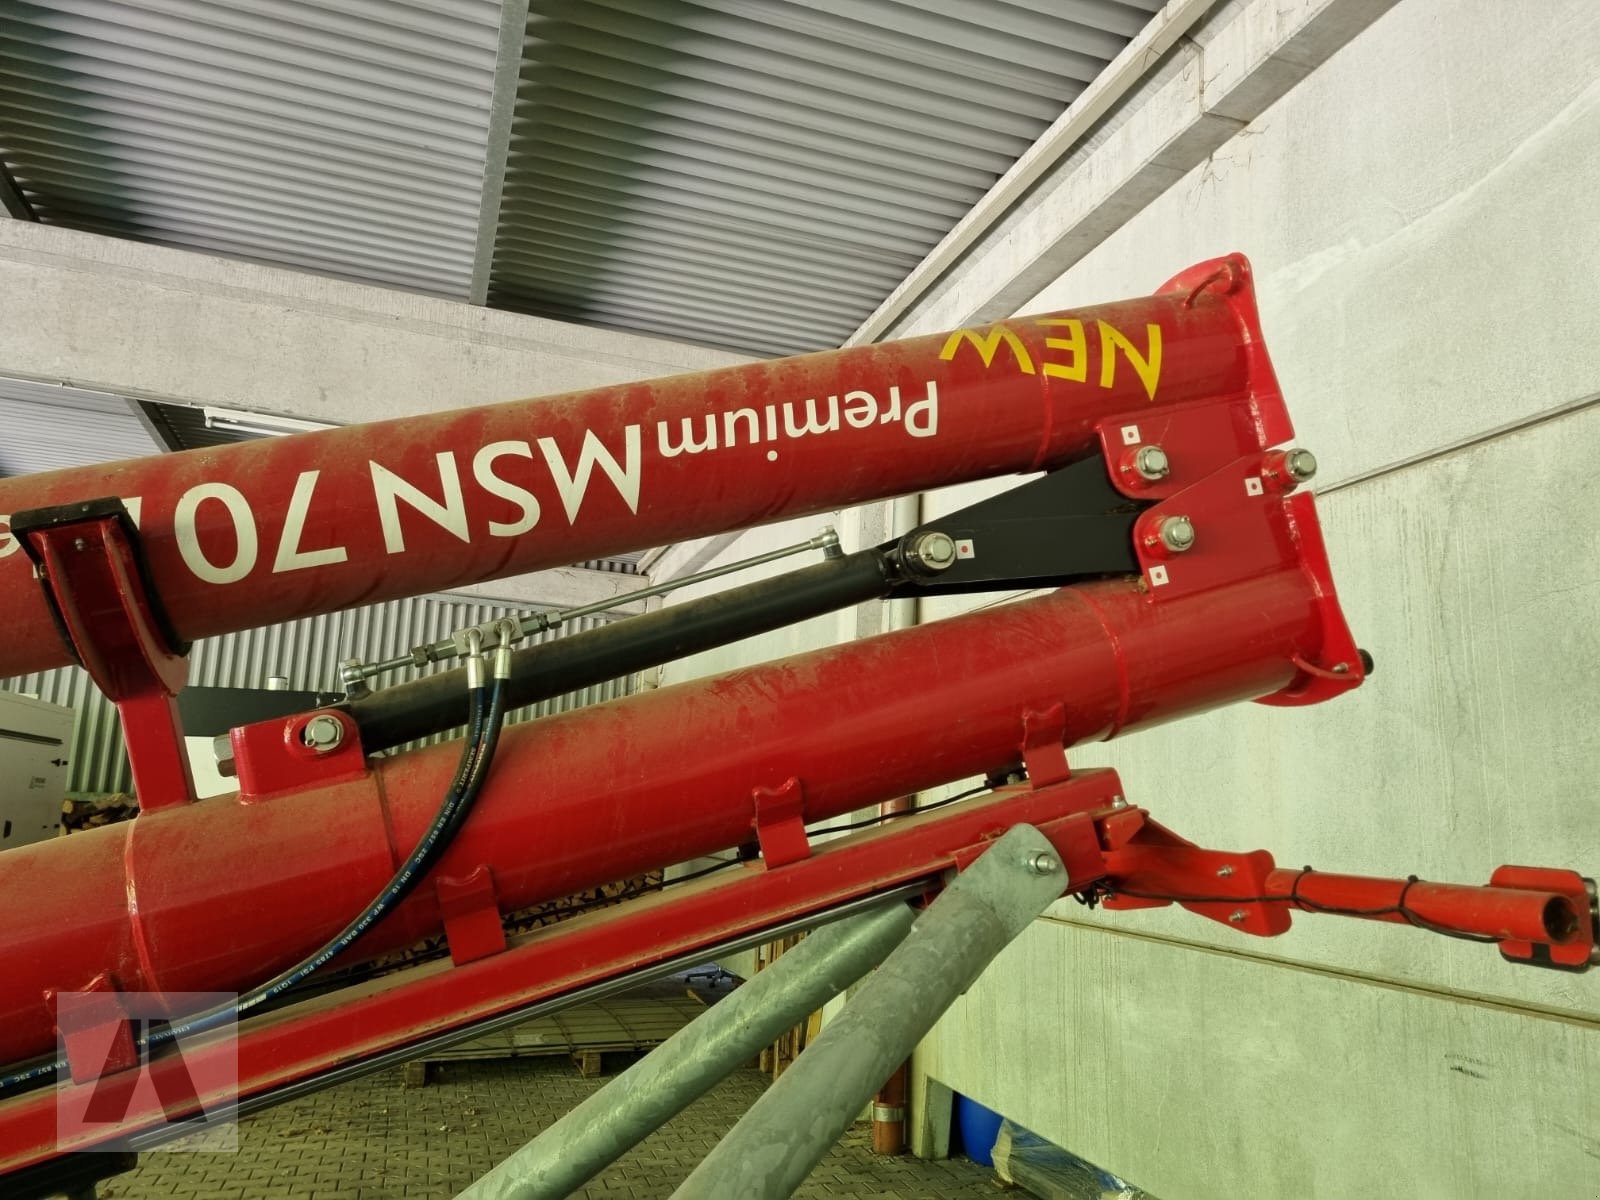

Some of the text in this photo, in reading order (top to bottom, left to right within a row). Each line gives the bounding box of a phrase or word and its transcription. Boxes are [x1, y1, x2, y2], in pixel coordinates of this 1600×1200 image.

[938, 318, 1162, 400] NEW
[656, 380, 939, 462] Premium
[174, 469, 348, 584] 70
[368, 423, 642, 554] MSN
